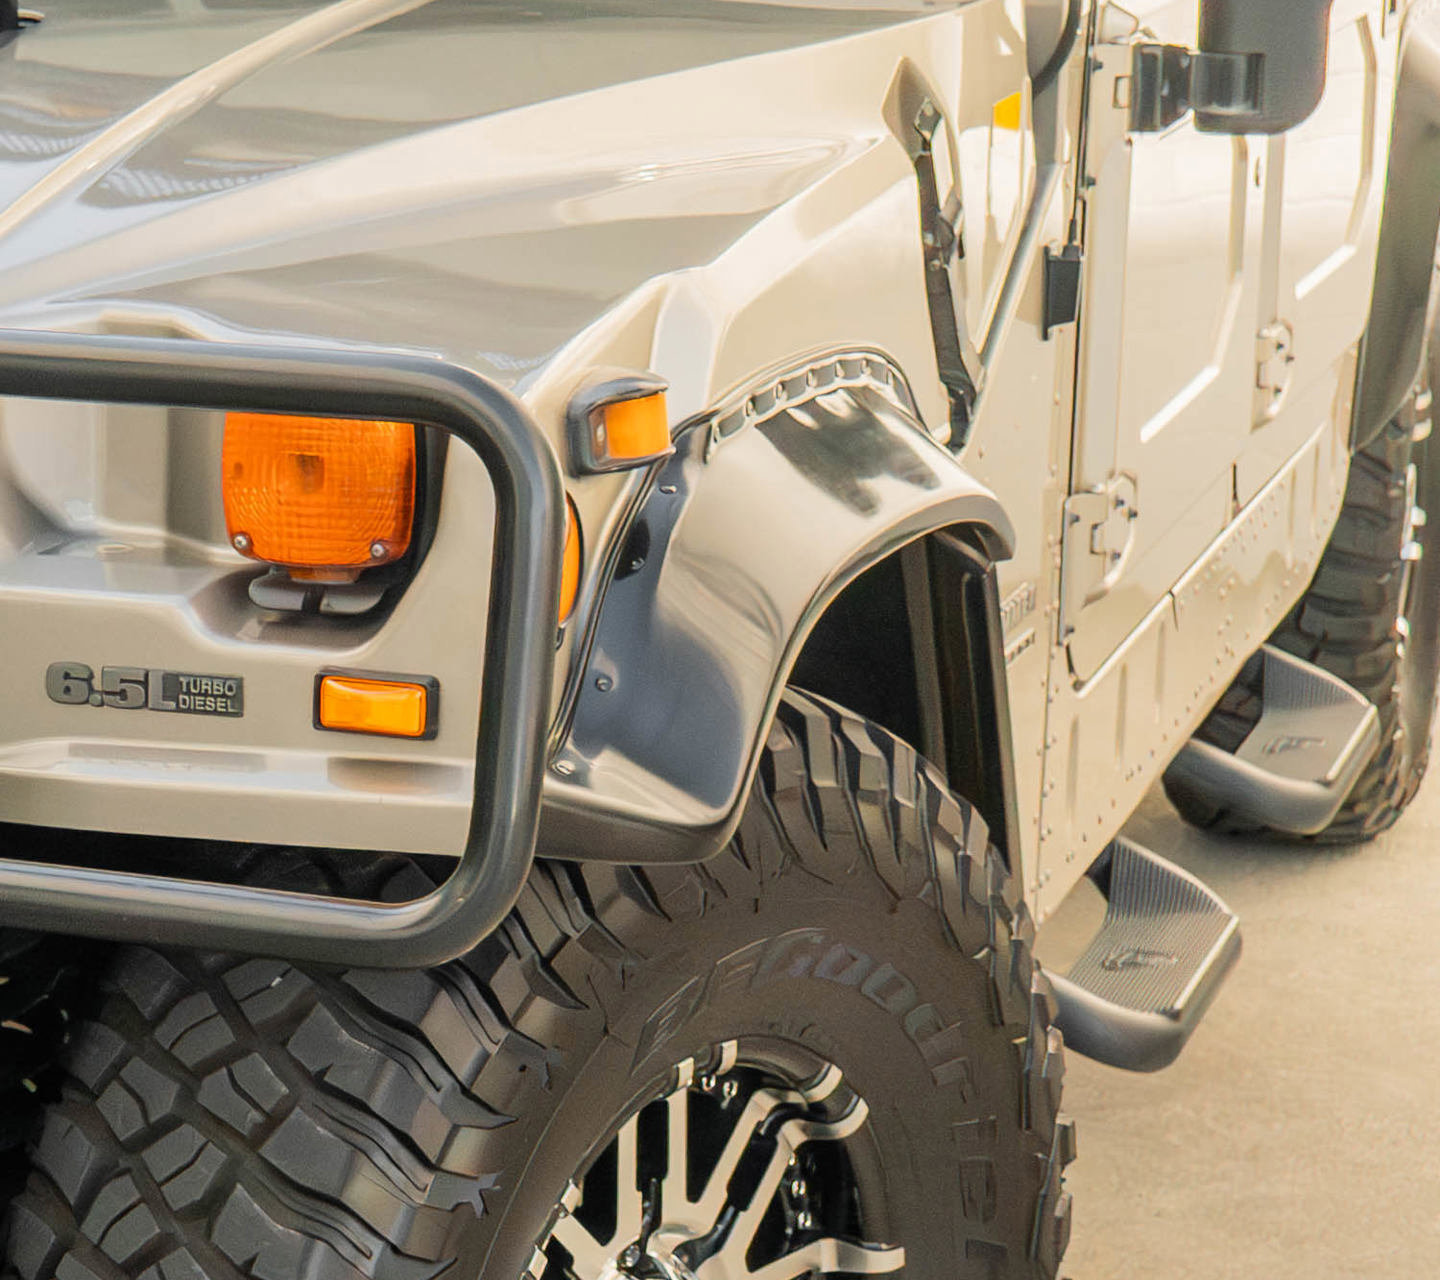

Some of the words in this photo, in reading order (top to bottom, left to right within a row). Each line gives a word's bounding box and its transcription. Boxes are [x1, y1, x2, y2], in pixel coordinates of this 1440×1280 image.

[46, 662, 177, 710] 6.5L
[180, 677, 237, 696] TURBO
[179, 694, 237, 713] DIESEL
